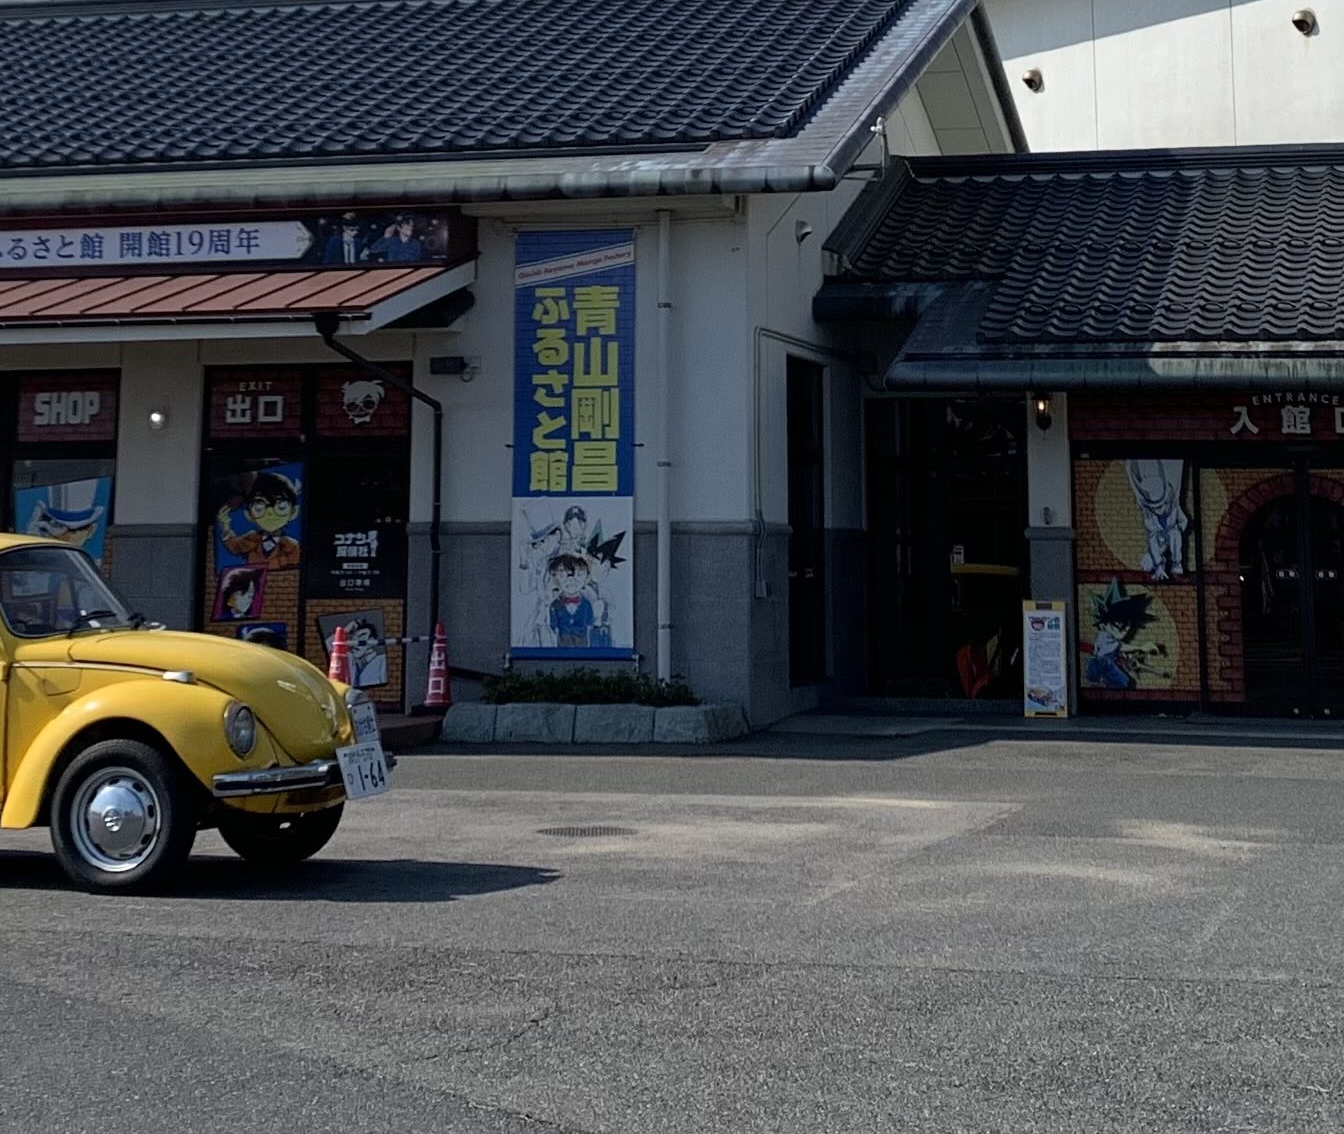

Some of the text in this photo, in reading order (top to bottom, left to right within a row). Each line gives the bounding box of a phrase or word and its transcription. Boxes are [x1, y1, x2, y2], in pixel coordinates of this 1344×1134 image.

[118, 227, 262, 259] 開館19周年
[239, 381, 273, 392] EXIT
[529, 286, 571, 493] ふるさと館
[570, 284, 621, 493] 青山剛昌
[1251, 392, 1341, 406] ENTRANCE
[33, 391, 100, 426] SHOP
[224, 394, 284, 423] 出口
